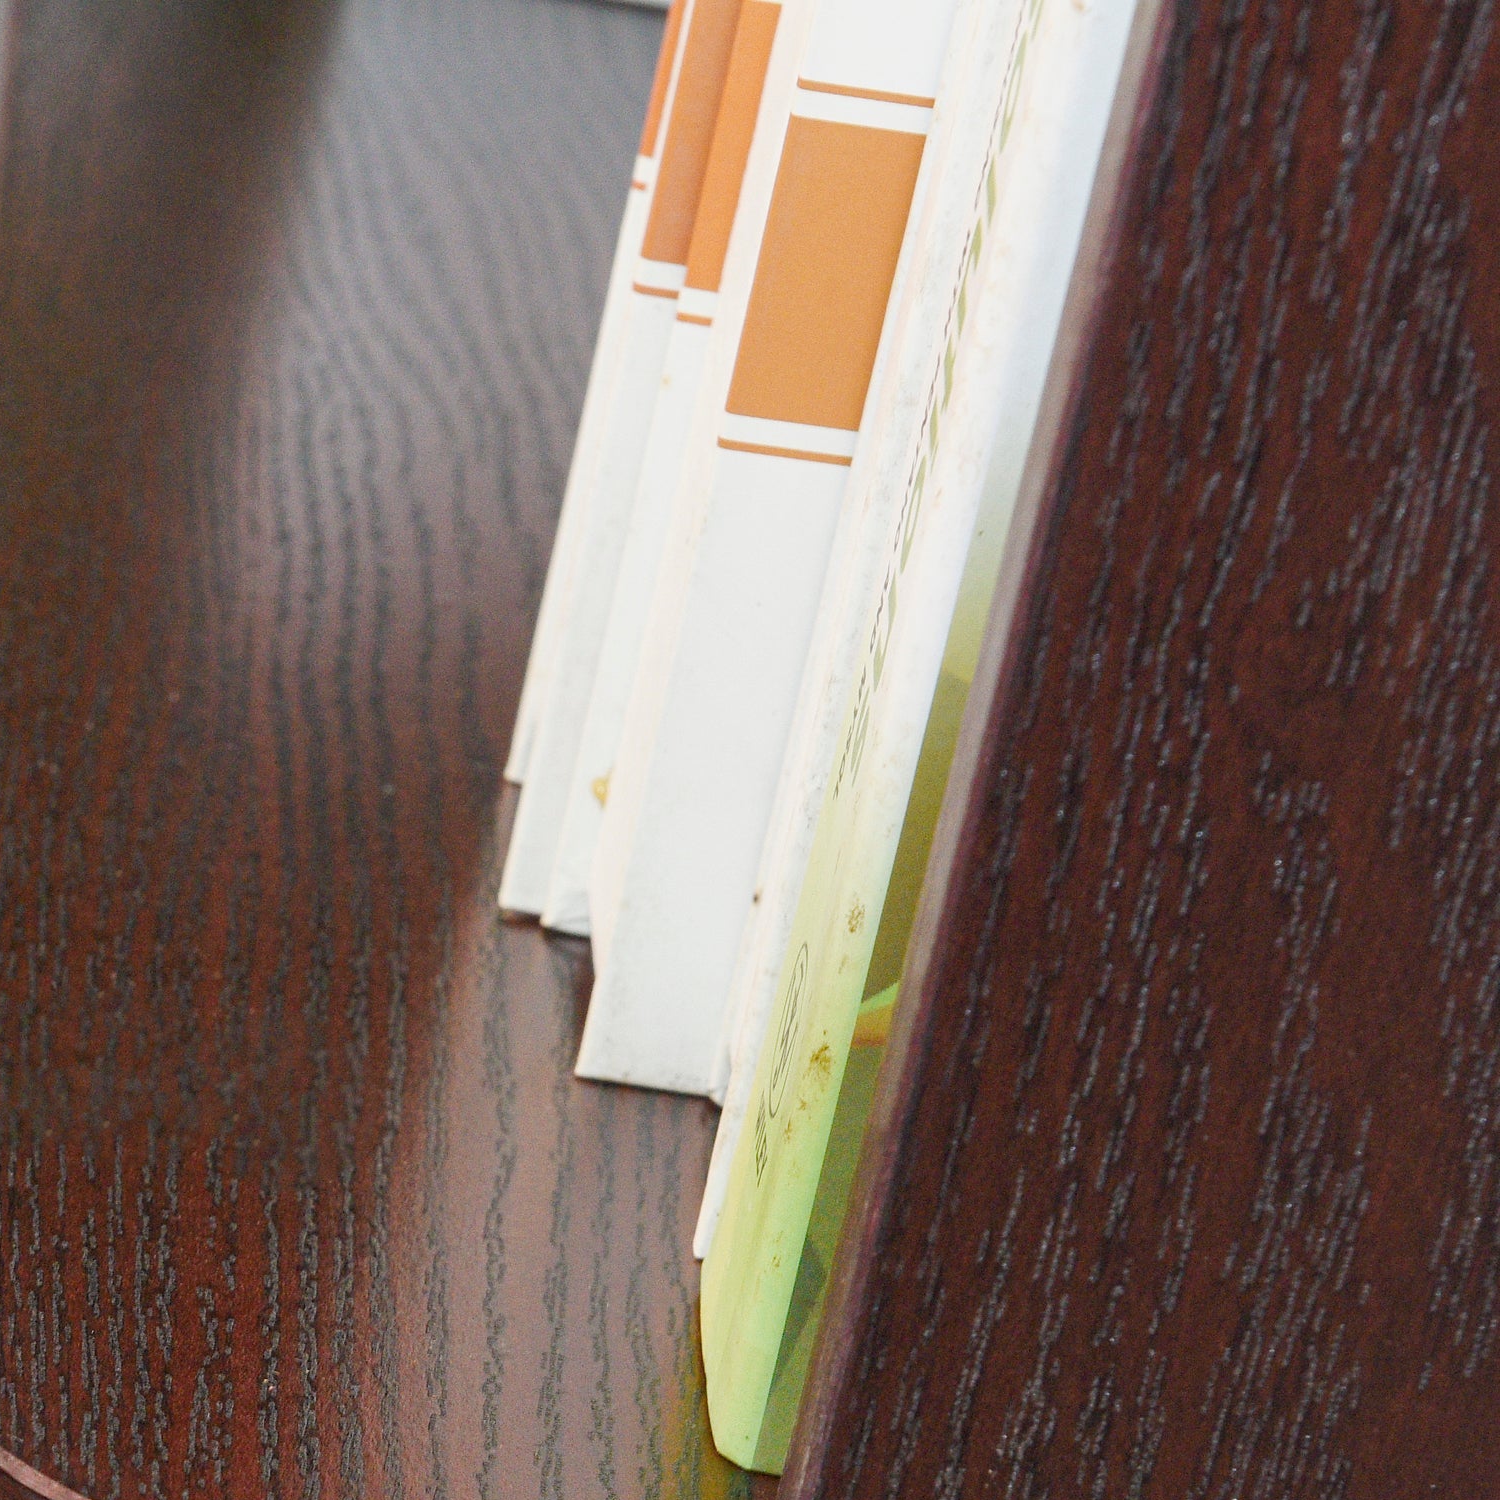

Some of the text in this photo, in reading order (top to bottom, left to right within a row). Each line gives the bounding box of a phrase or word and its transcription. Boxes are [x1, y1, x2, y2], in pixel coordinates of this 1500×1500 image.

[944, 229, 971, 340] WITH
[893, 351, 941, 553] PENTAHO
[869, 560, 891, 655] AND
